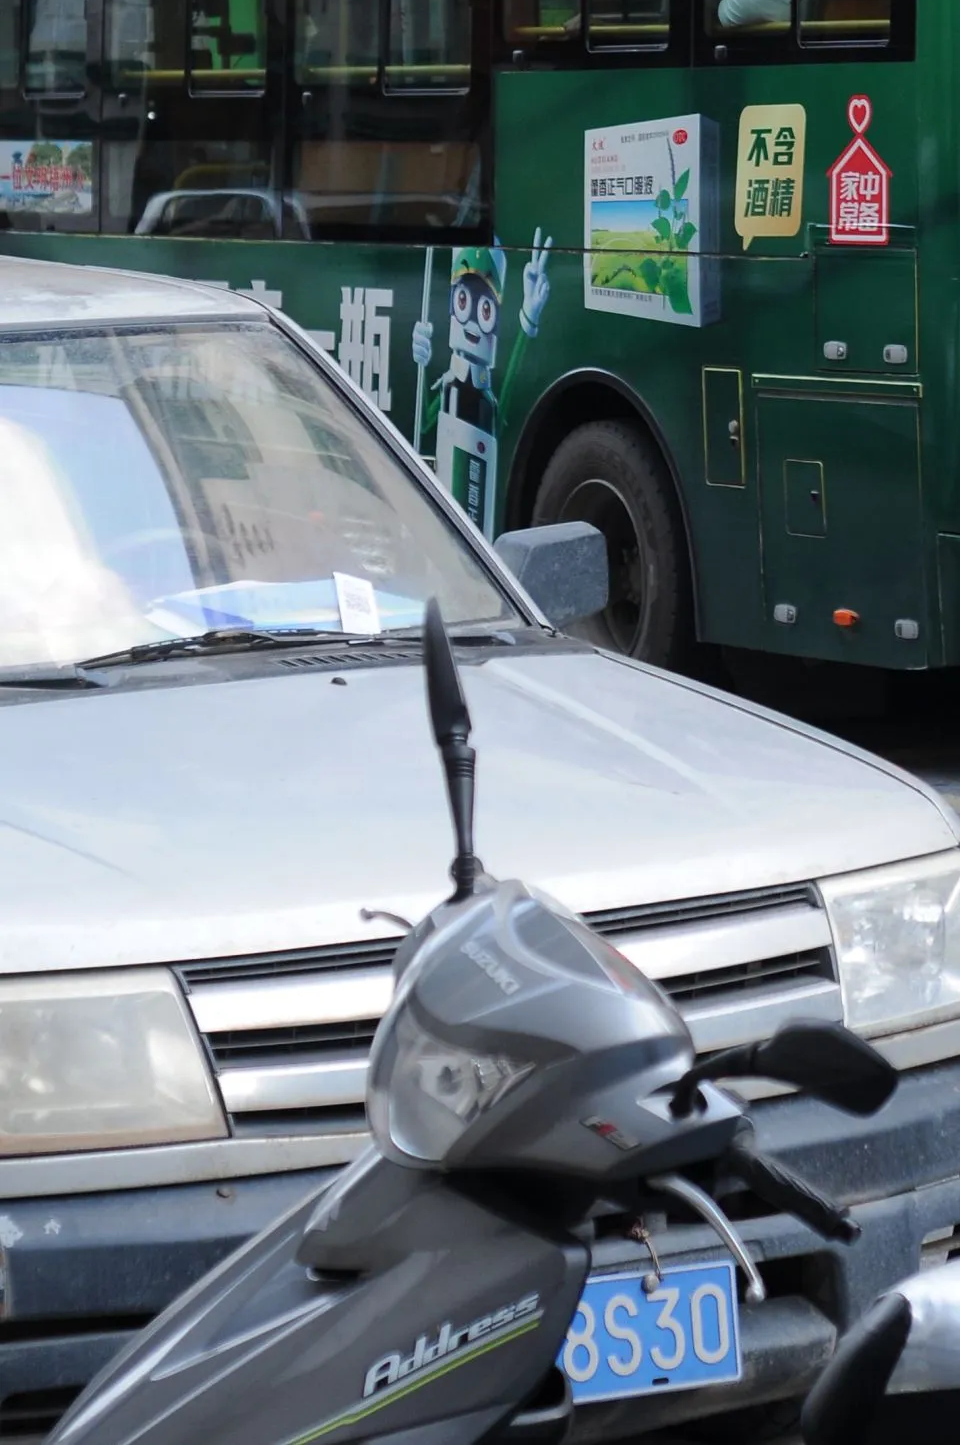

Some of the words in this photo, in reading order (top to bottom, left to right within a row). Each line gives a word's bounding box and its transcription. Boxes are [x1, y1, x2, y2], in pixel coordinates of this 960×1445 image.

[747, 127, 796, 167] 不含
[744, 178, 796, 218] 酒精
[839, 171, 880, 201] 家中
[837, 201, 880, 233] 常备
[362, 1292, 540, 1400] Address
